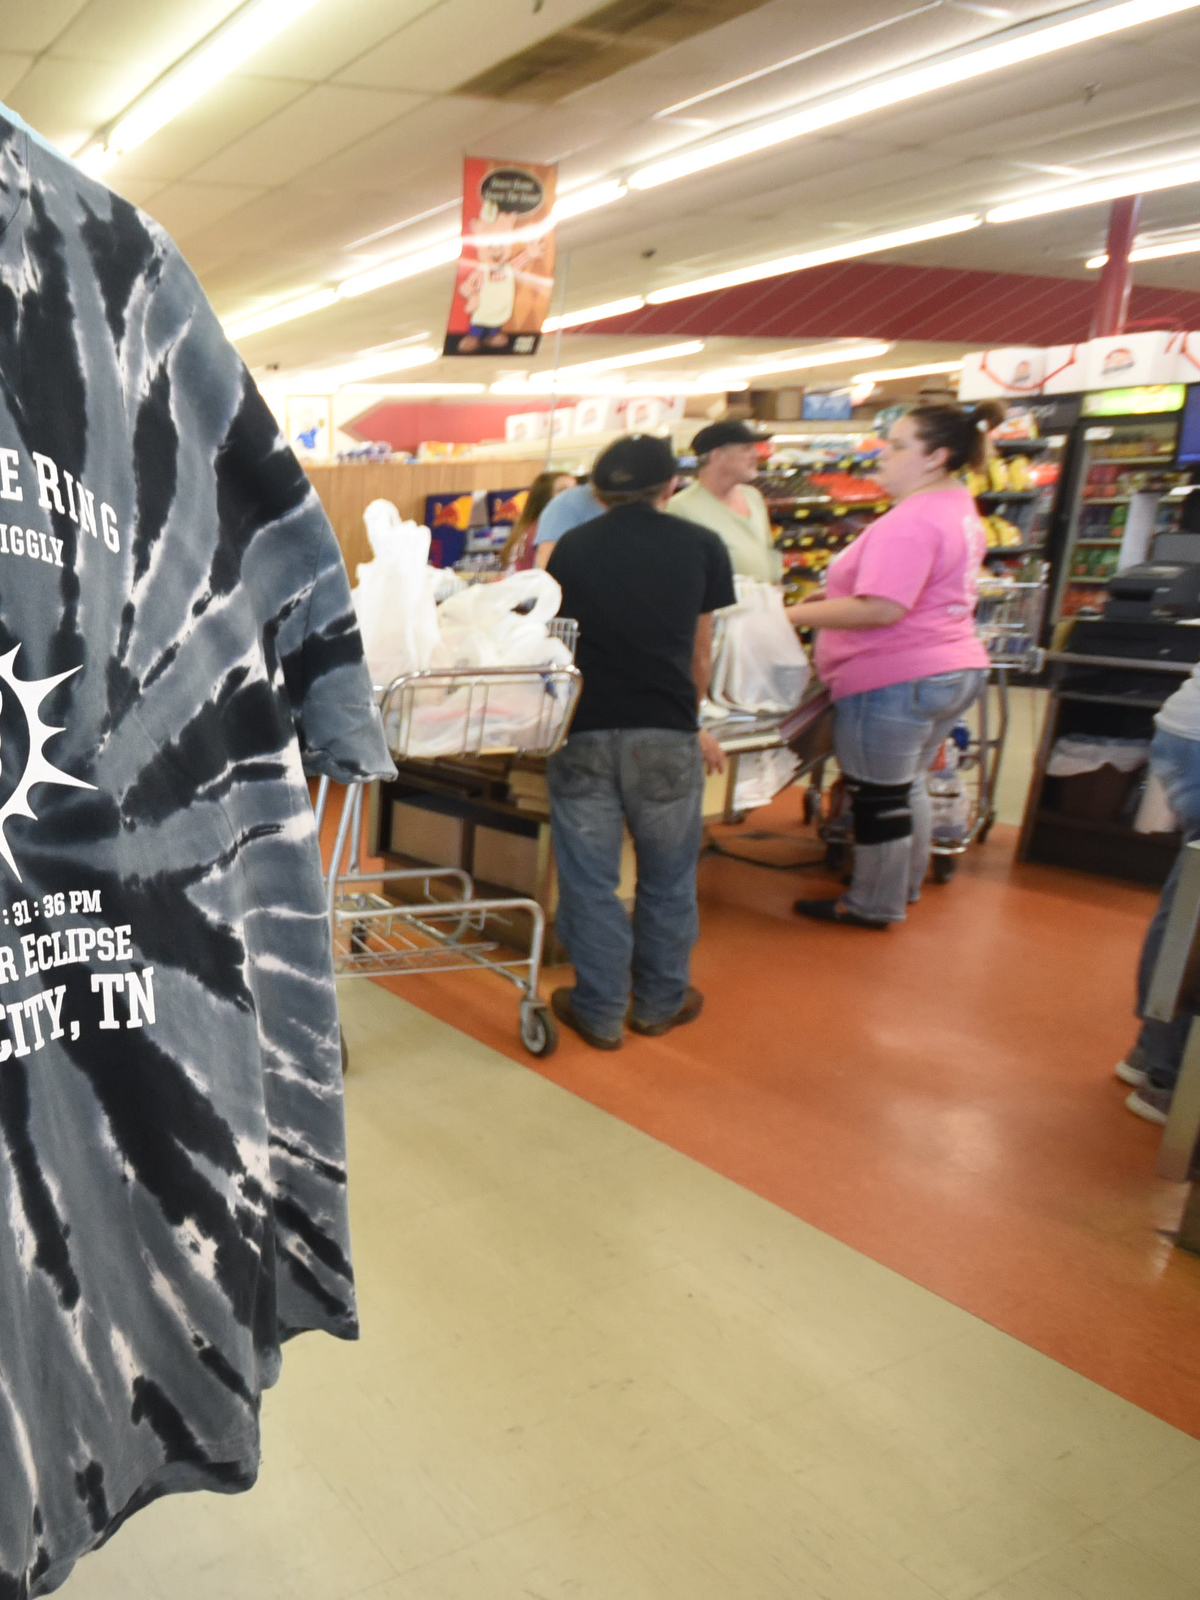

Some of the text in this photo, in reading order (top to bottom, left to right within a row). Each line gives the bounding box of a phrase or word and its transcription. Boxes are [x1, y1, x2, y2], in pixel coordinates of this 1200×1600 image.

[33, 451, 120, 553] RING
[69, 890, 102, 914] PM
[20, 924, 133, 977] ECLIPSE
[90, 966, 156, 1029] TN
